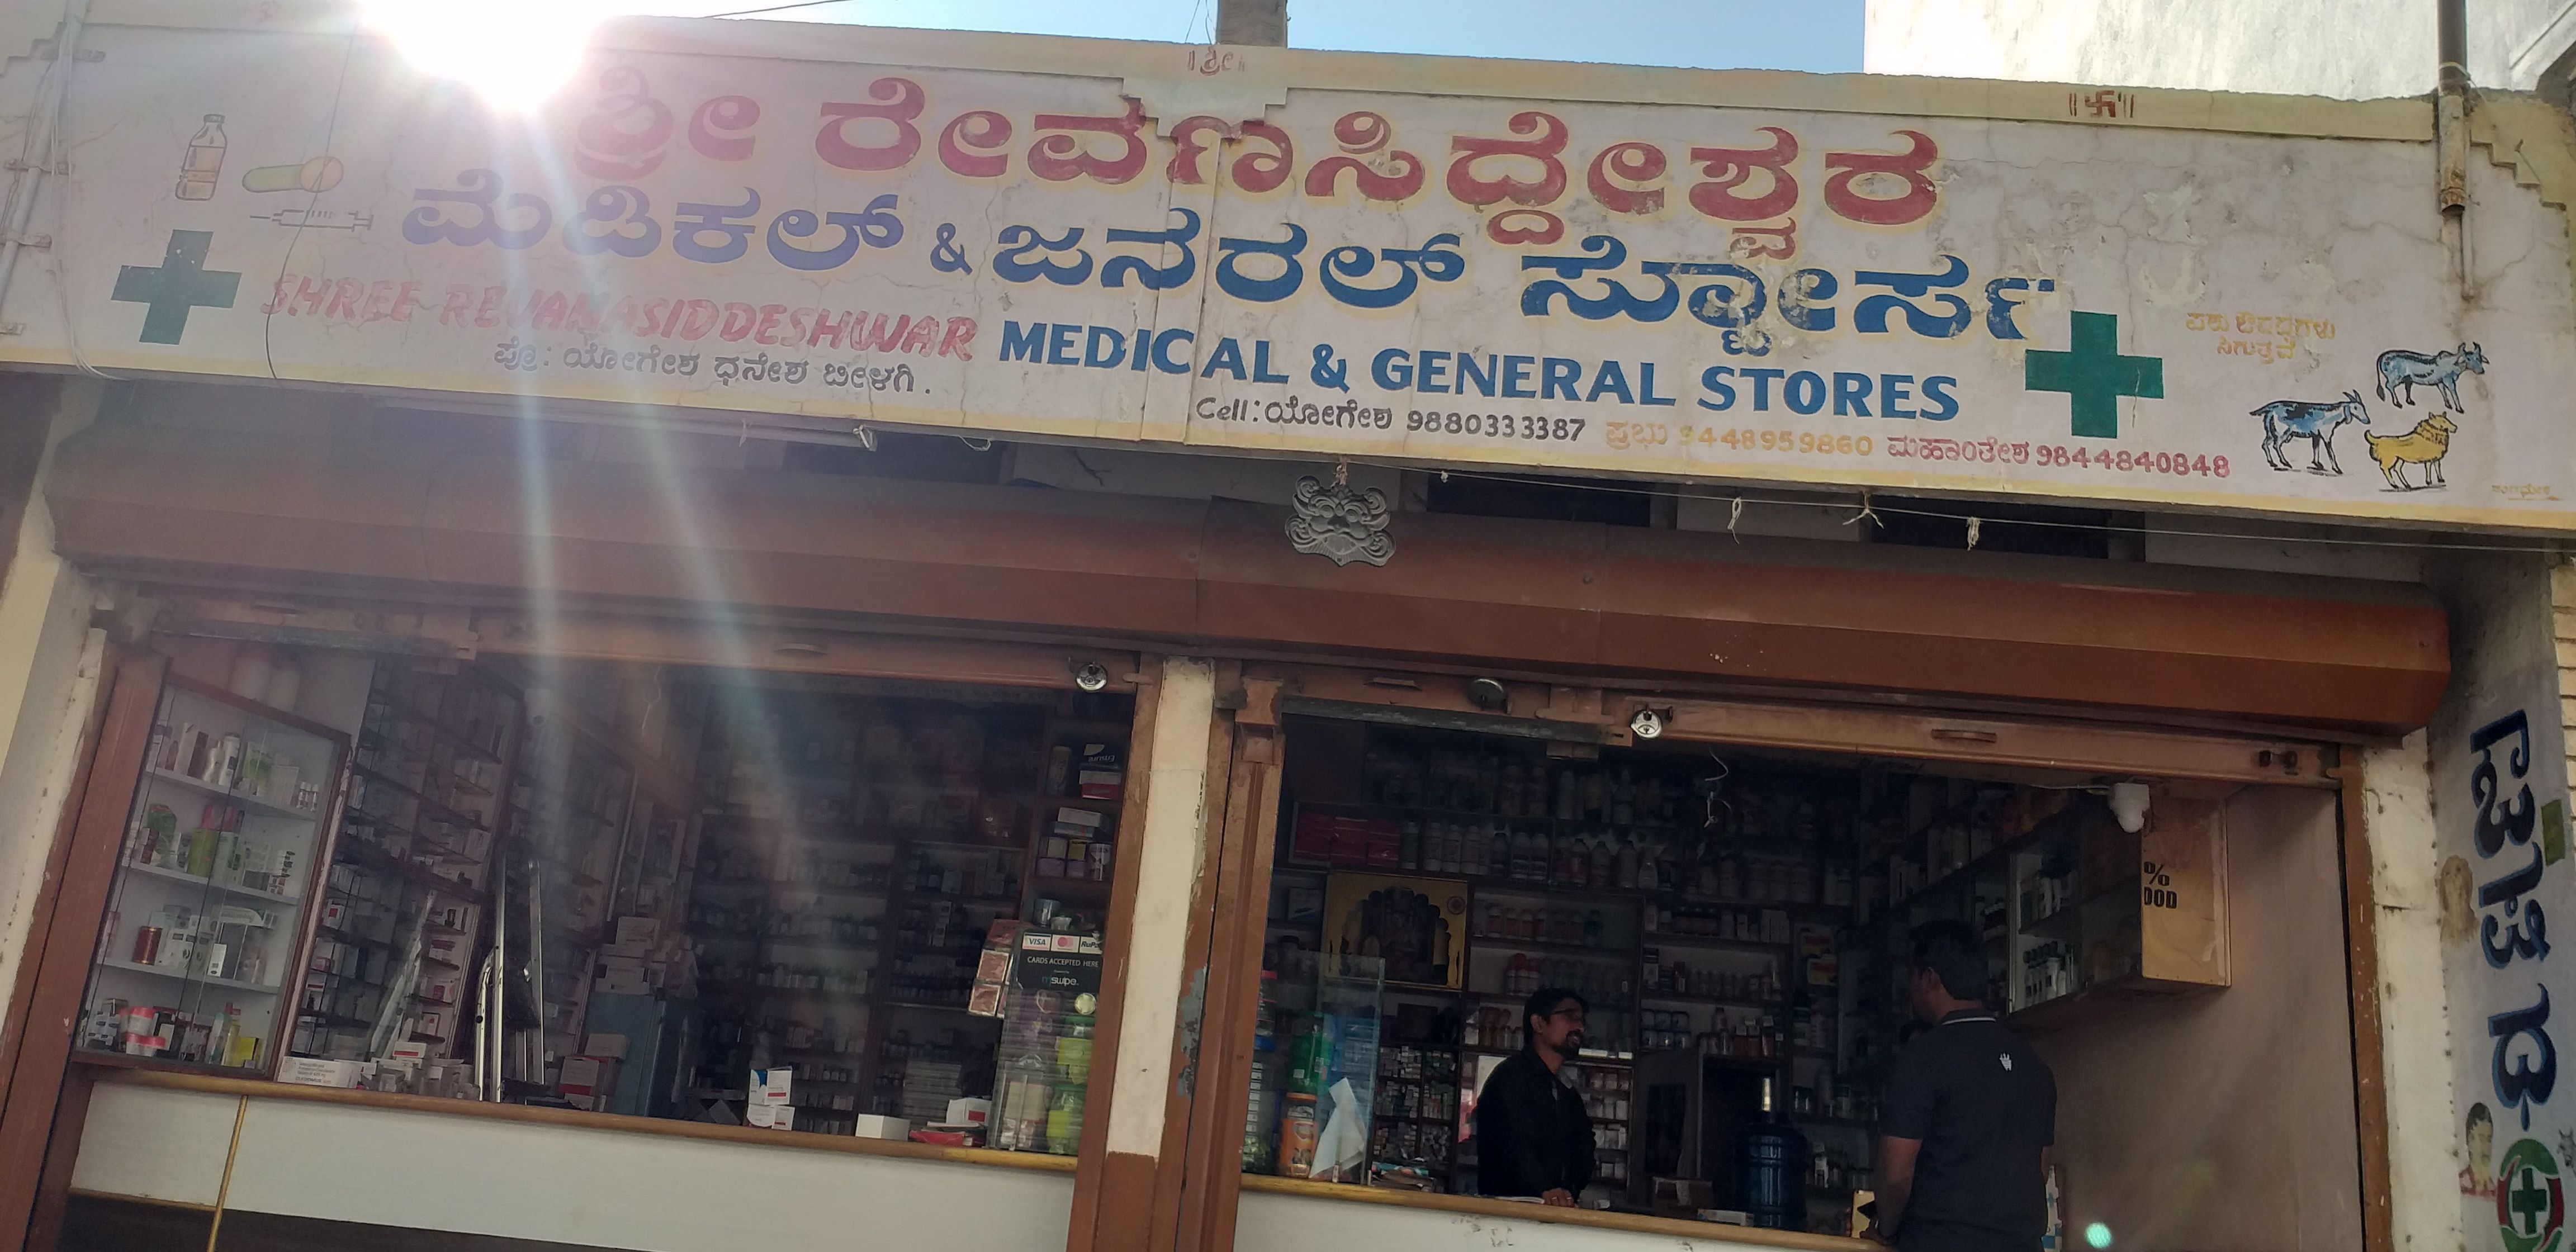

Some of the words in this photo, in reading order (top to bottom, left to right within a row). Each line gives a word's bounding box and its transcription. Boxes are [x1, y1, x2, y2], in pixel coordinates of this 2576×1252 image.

[572, 65, 761, 181] ಶ್ರೀ
[401, 168, 905, 271] ಮೆಡಿಕಲ್
[929, 222, 973, 275] &
[992, 207, 1466, 310] ಜನರಲ್
[261, 274, 423, 321] SHREE
[439, 283, 978, 363] REVANASIDDESHWAR
[998, 321, 1289, 384] MEDICAL
[1310, 343, 1349, 393] &
[1371, 348, 1677, 407] GENERAL
[1697, 365, 1959, 421] STORES
[1407, 409, 1587, 442] 9880333387
[2036, 444, 2231, 478] 9844840848
[1027, 956, 1048, 964] CARDS
[1049, 958, 1081, 966] ACCEPTED
[1029, 937, 1046, 946] VISA
